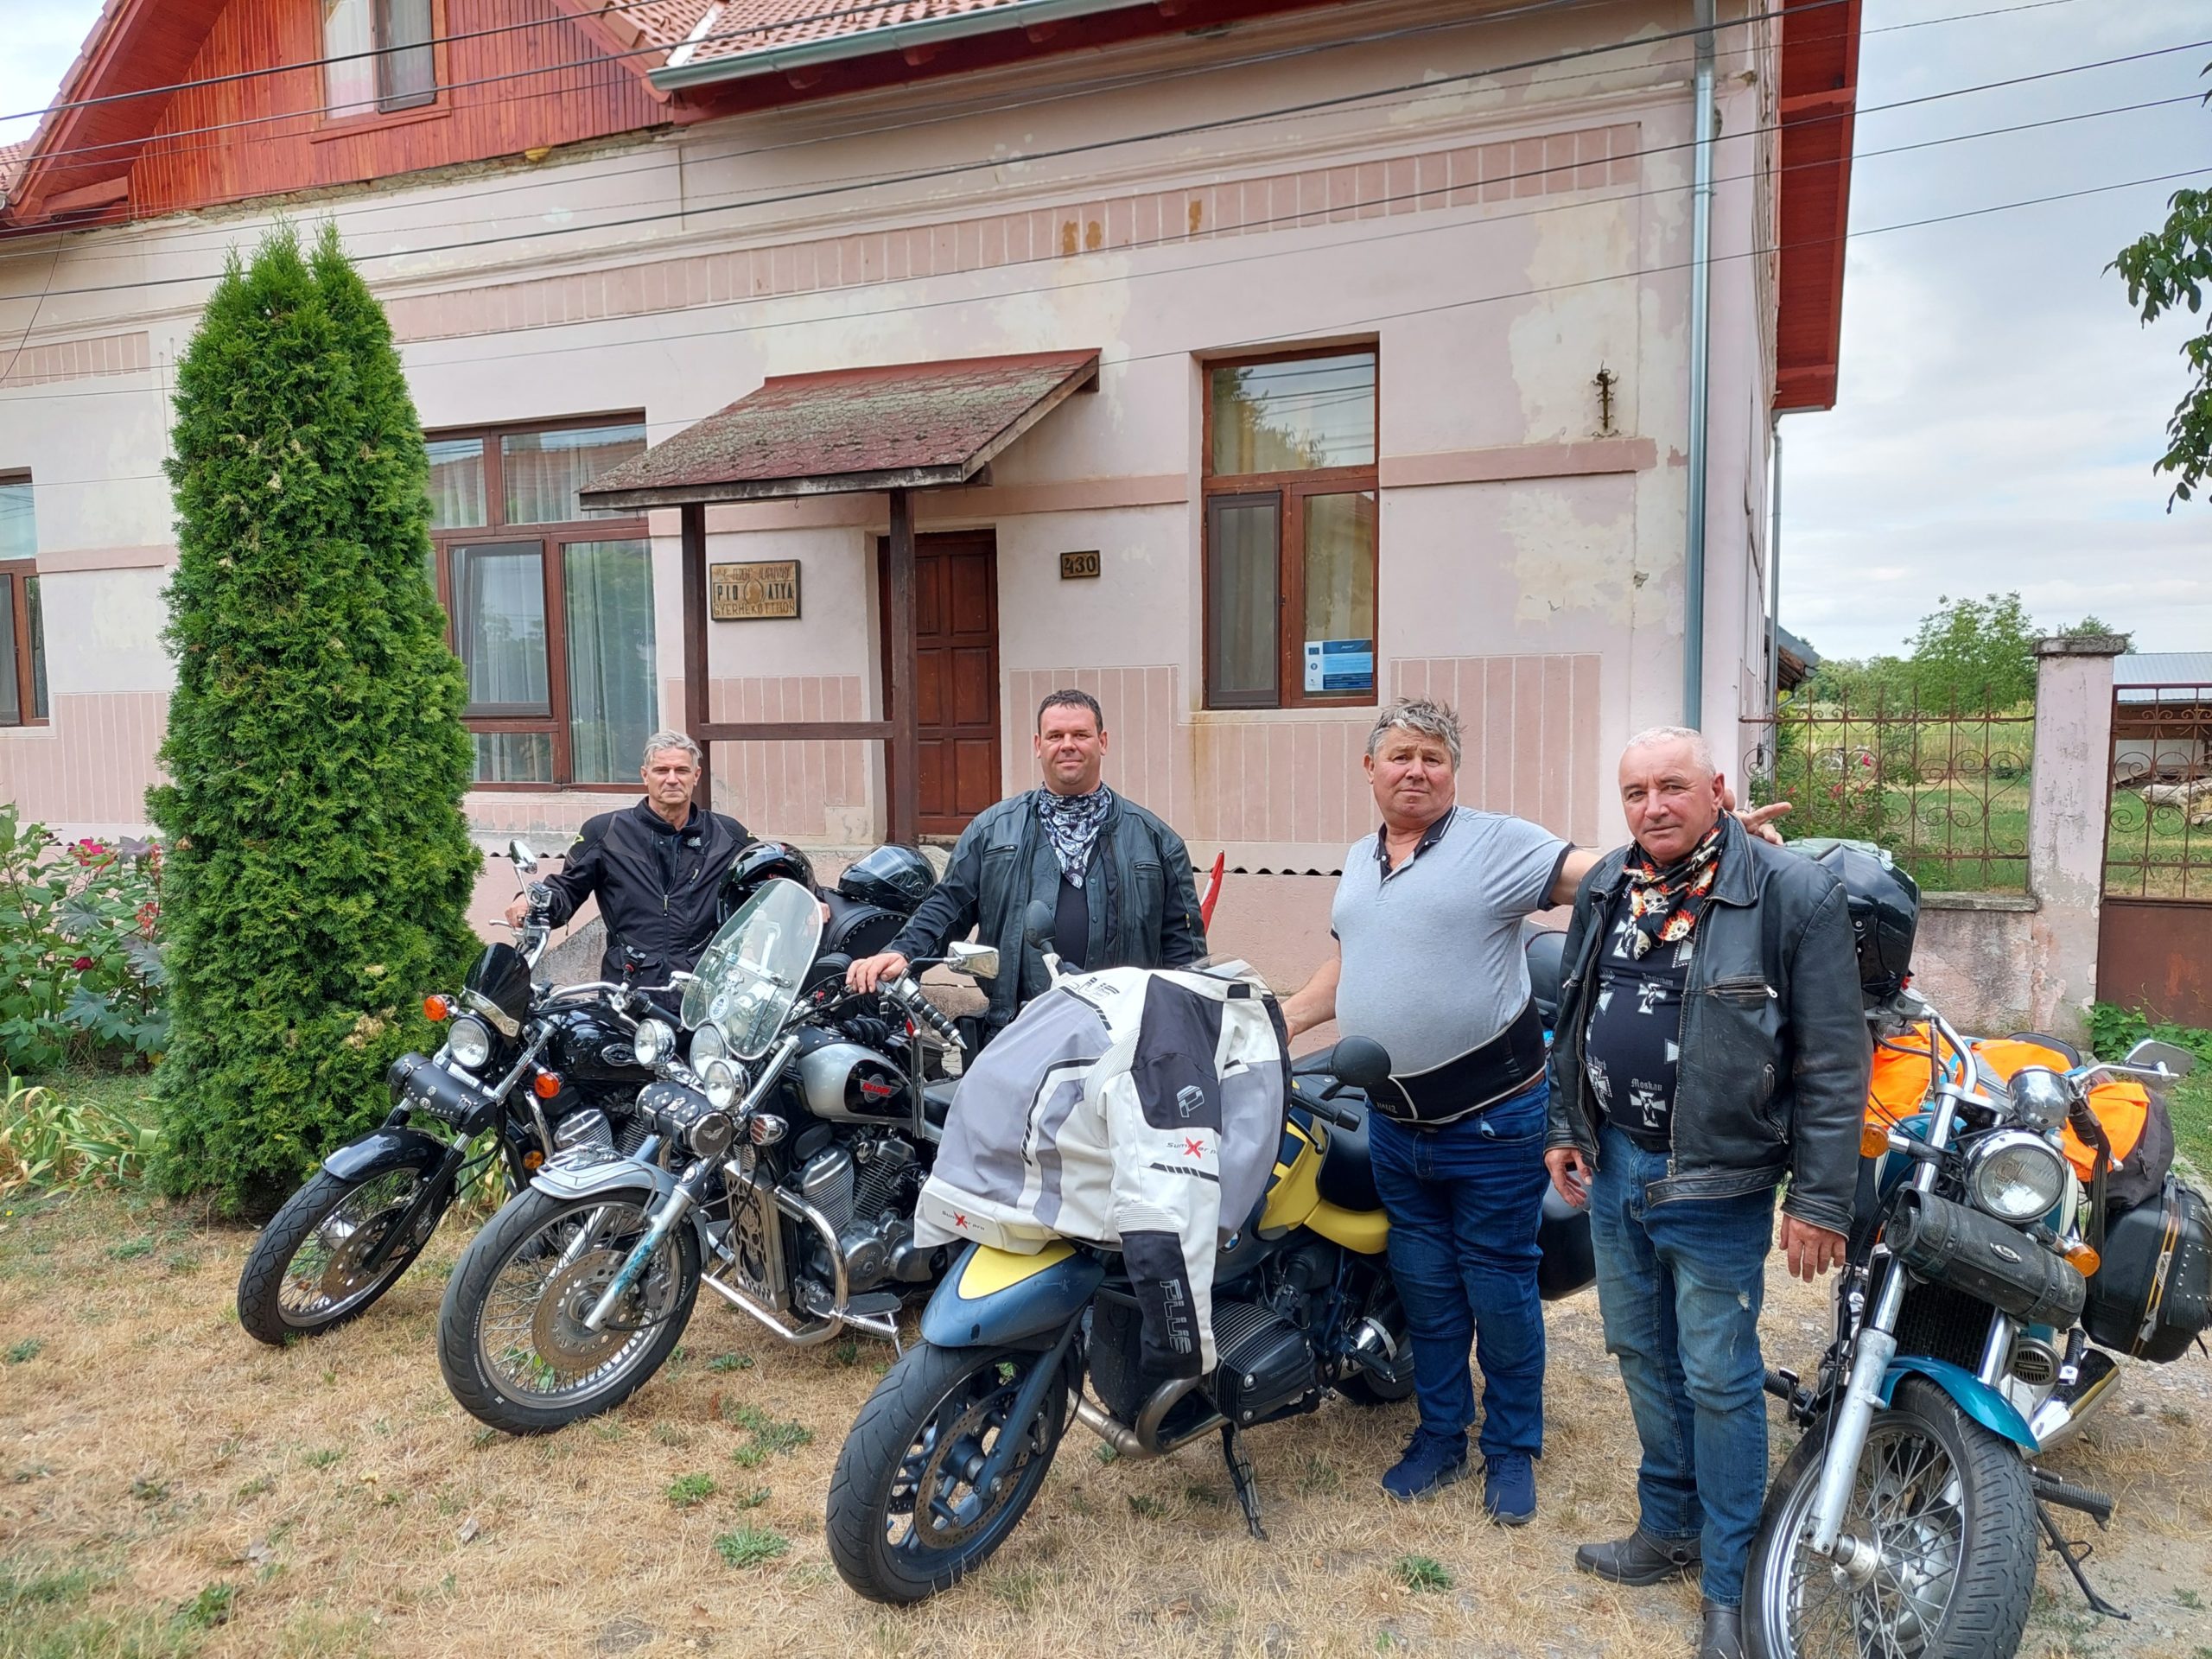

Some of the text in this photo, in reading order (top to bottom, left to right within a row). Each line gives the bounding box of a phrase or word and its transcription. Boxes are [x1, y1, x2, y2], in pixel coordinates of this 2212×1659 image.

[1064, 555, 1096, 574] 430
[717, 582, 793, 601] PIO ATYA
[1630, 1077, 1662, 1091] Moskau
[1159, 1278, 1192, 1355] PLUS
